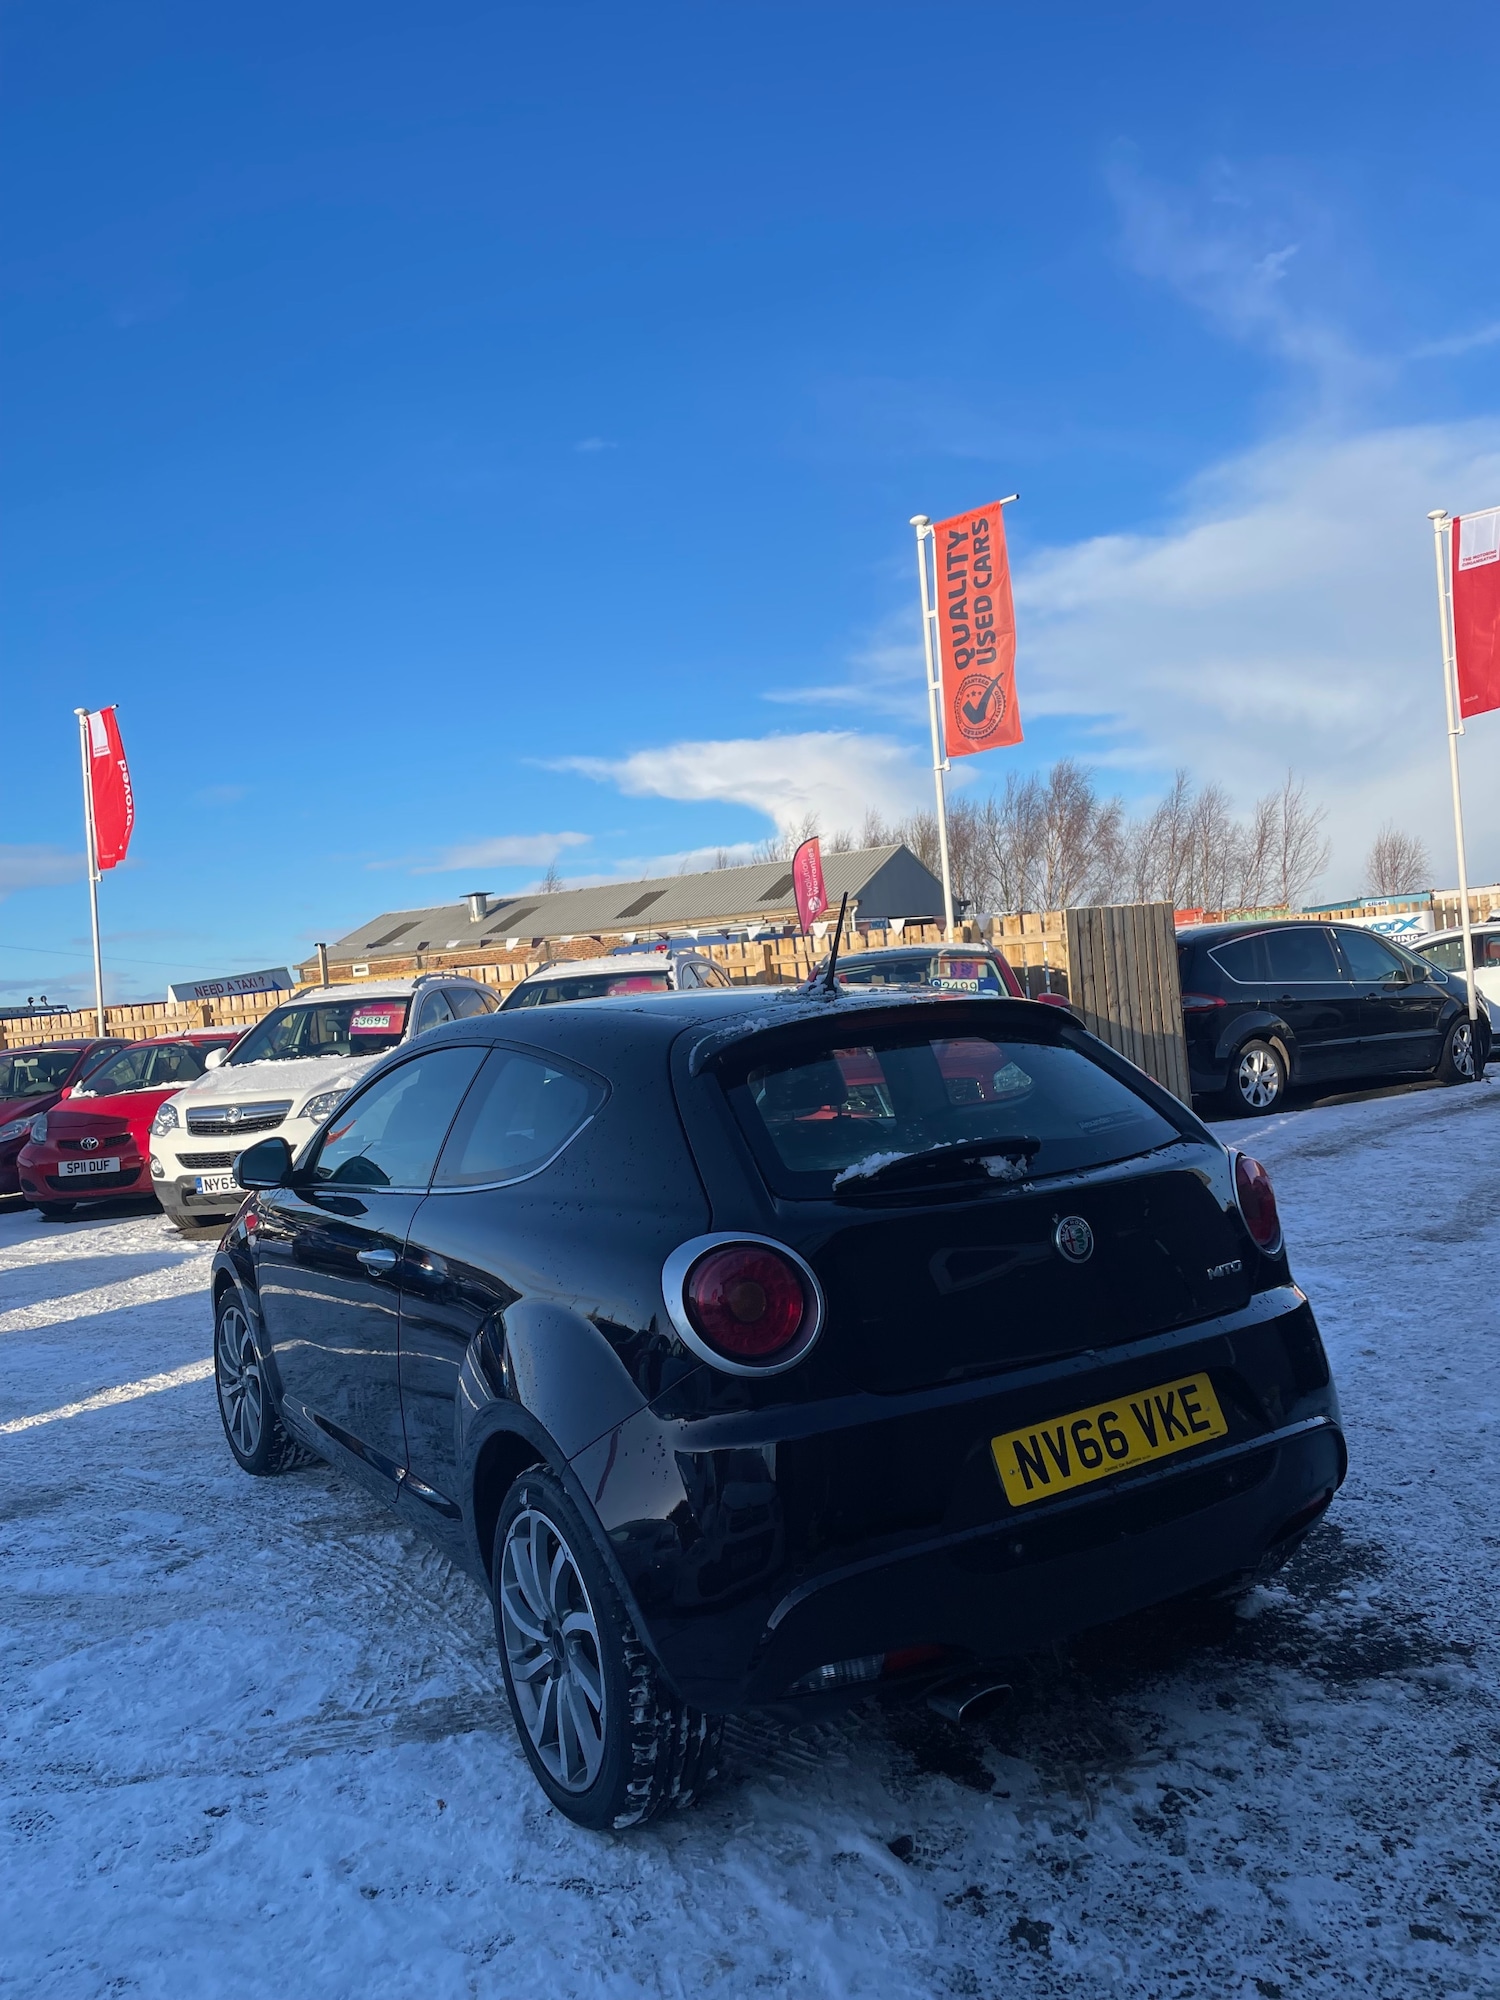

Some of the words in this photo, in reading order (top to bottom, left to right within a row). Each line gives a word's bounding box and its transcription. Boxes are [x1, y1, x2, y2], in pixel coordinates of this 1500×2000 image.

[972, 518, 992, 588] CARS
[947, 530, 975, 670] QUALITY
[974, 595, 996, 666] USED
[117, 759, 133, 828] proved
[801, 859, 813, 897] Evolution
[808, 847, 820, 895] Warranties
[194, 983, 224, 998] NEED
[227, 981, 235, 992] A
[234, 979, 258, 991] TAXI
[351, 1016, 389, 1027] £3695
[1012, 1411, 1129, 1490] NV66
[1130, 1384, 1211, 1448] VKE
